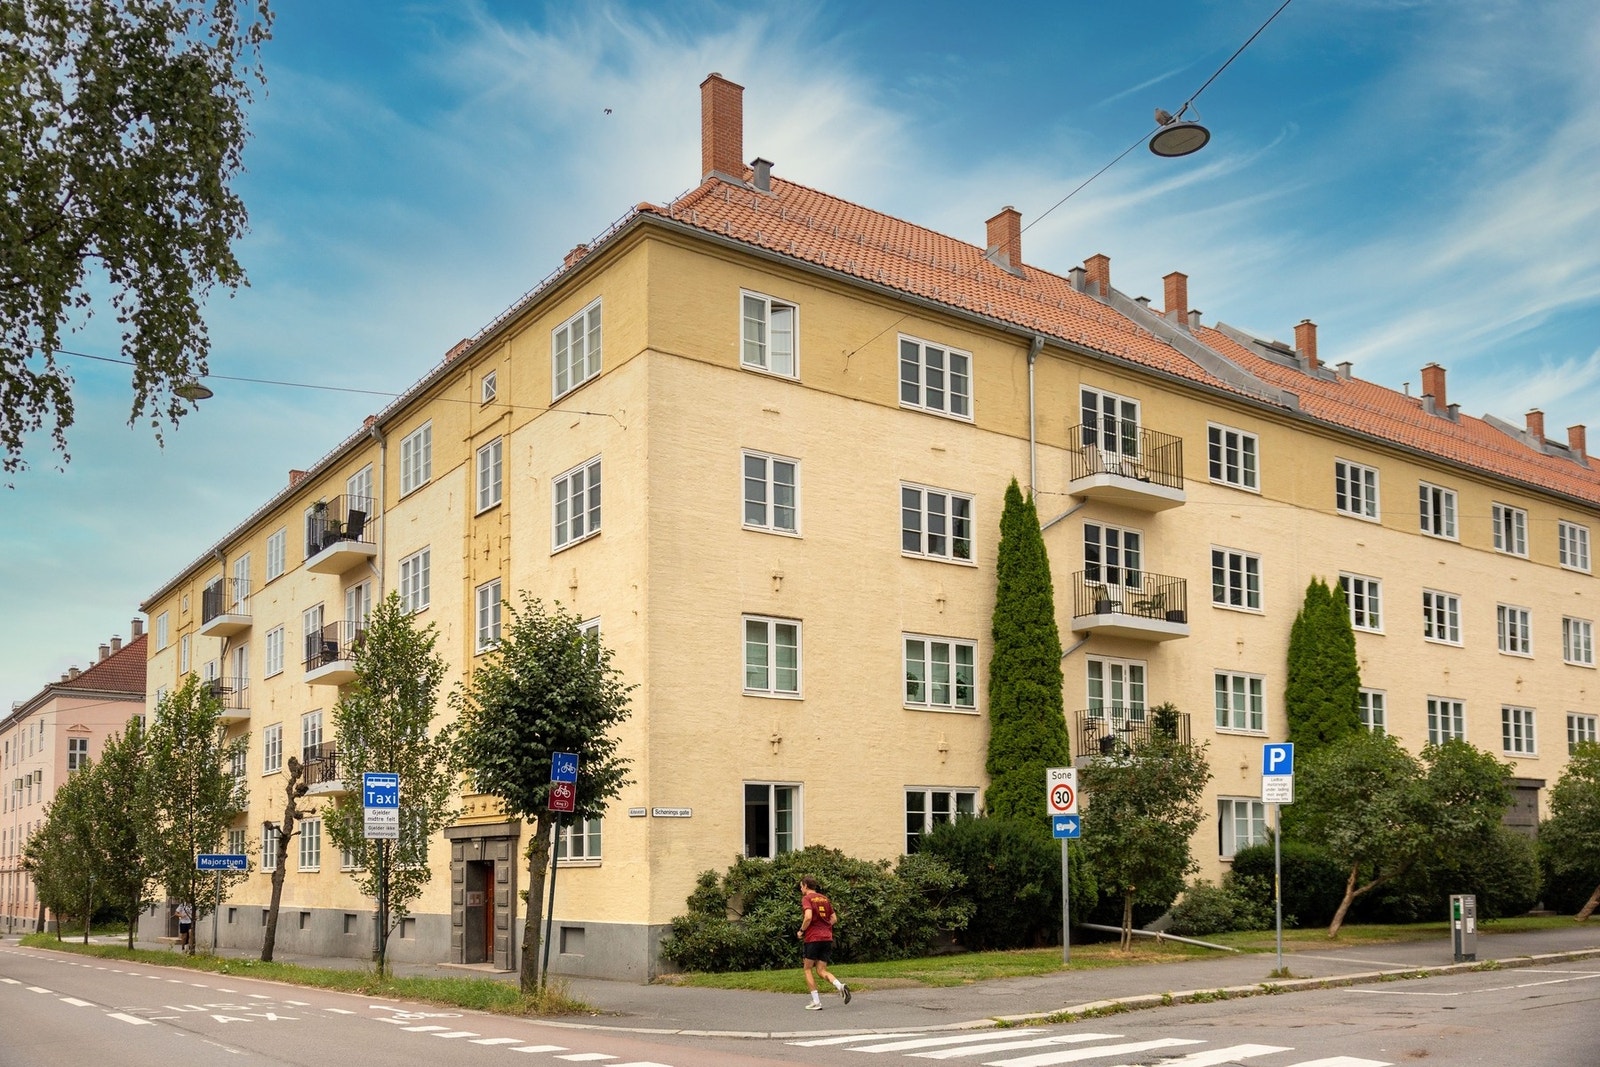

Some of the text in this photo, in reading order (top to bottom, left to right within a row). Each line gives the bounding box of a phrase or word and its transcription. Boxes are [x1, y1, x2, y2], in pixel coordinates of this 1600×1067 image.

[1270, 748, 1286, 772] P
[1051, 771, 1072, 780] Sone
[367, 792, 396, 804] Taxi
[1055, 791, 1070, 804] 30
[201, 858, 243, 866] Majorstuen
